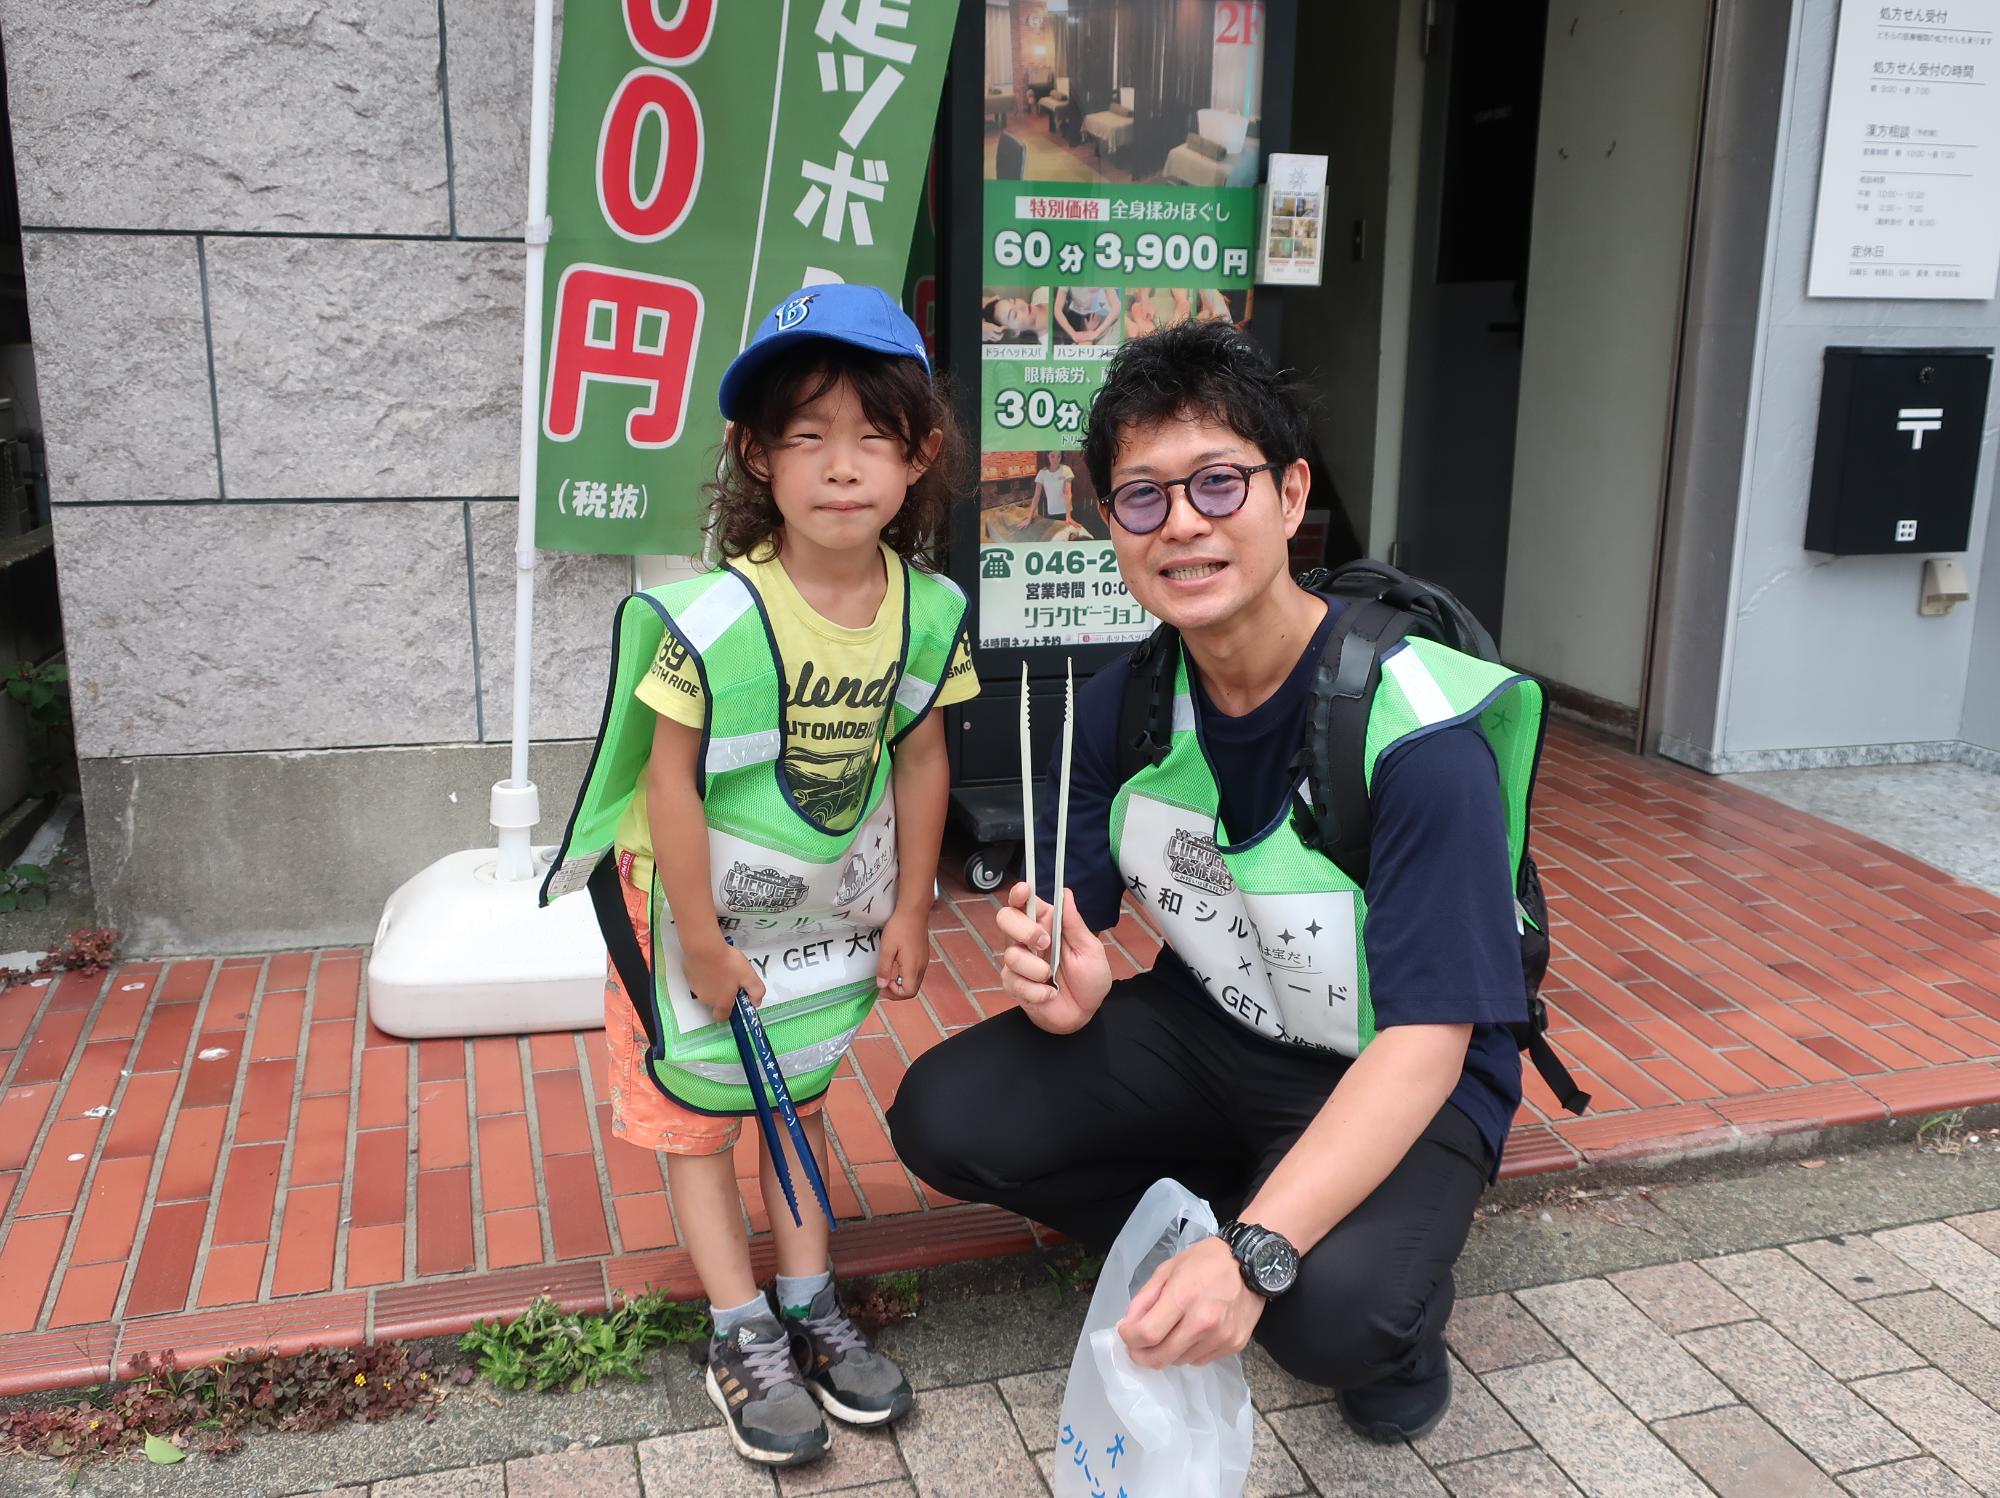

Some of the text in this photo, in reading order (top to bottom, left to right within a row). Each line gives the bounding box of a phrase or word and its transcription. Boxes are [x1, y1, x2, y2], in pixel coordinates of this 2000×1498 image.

[1880, 7, 1948, 24] 処方せん受付
[1873, 61, 1975, 79] 処方せん受付の時間
[793, 0, 917, 288] 足ツボ
[1865, 124, 1911, 138] 漢方相談
[1029, 197, 1231, 222] 特別価格 全身揉みほぐし
[1095, 232, 1249, 277] 3,900円
[1851, 245, 1885, 257] 定休日
[995, 388, 1083, 431] 30分
[558, 478, 649, 520] (税抜)
[1026, 582, 1085, 600] 営業時間
[1024, 602, 1147, 628] リラクゼーション
[668, 673, 700, 698] RIDE
[786, 660, 900, 708] lend
[782, 939, 835, 972] GET
[1221, 985, 1268, 1027] GET
